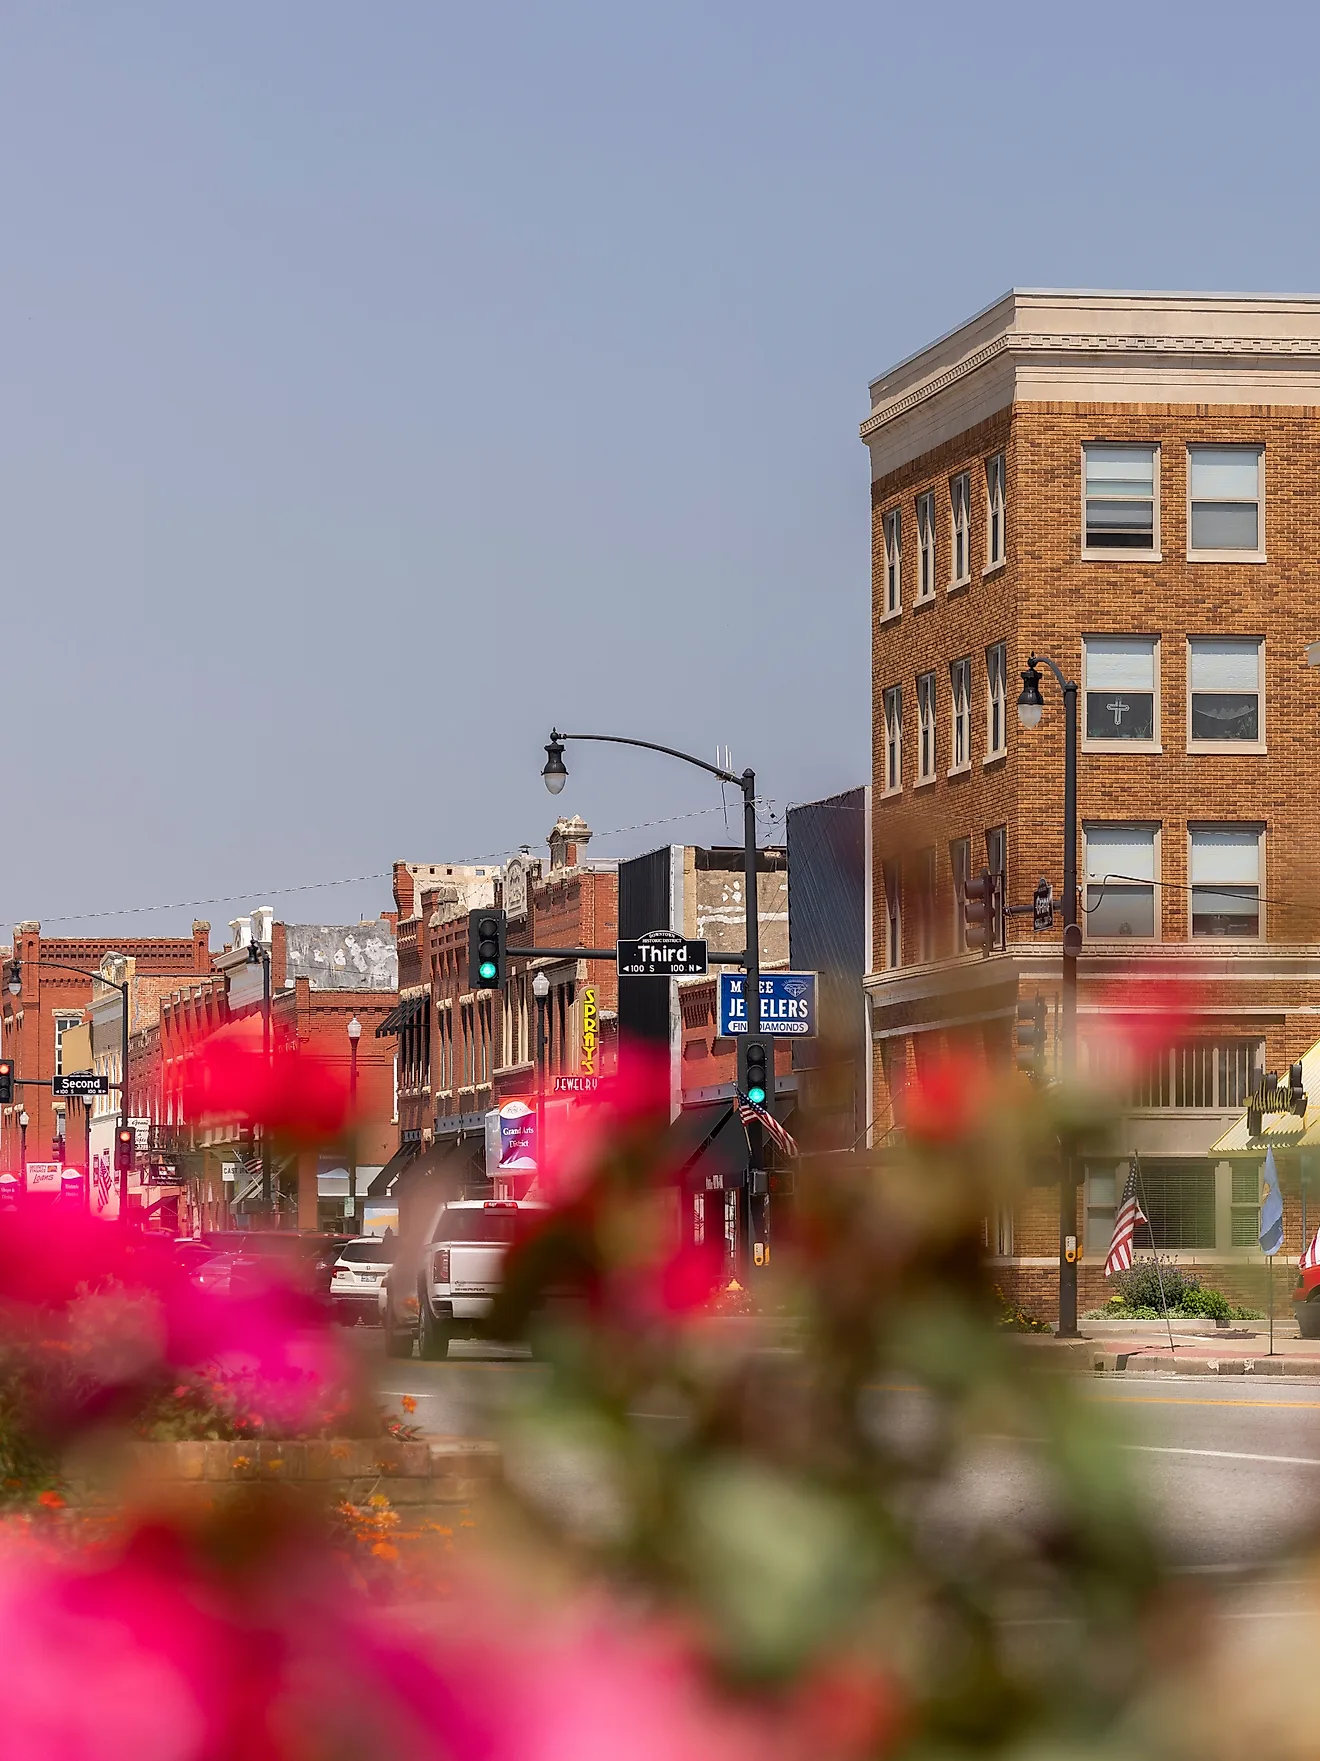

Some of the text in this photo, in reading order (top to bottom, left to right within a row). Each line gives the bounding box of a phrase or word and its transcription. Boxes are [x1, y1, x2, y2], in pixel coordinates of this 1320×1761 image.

[637, 944, 687, 963] Third
[630, 964, 655, 973] 100 S
[670, 964, 695, 973] 100 N
[730, 980, 774, 994] MEE
[728, 998, 809, 1018] JEELERS
[732, 1022, 747, 1031] FIN
[61, 1078, 101, 1089] Second
[555, 1078, 598, 1091] JEWELRY
[502, 1126, 521, 1136] Grand
[224, 1167, 238, 1175] CAST
[33, 1173, 54, 1184] Loans
